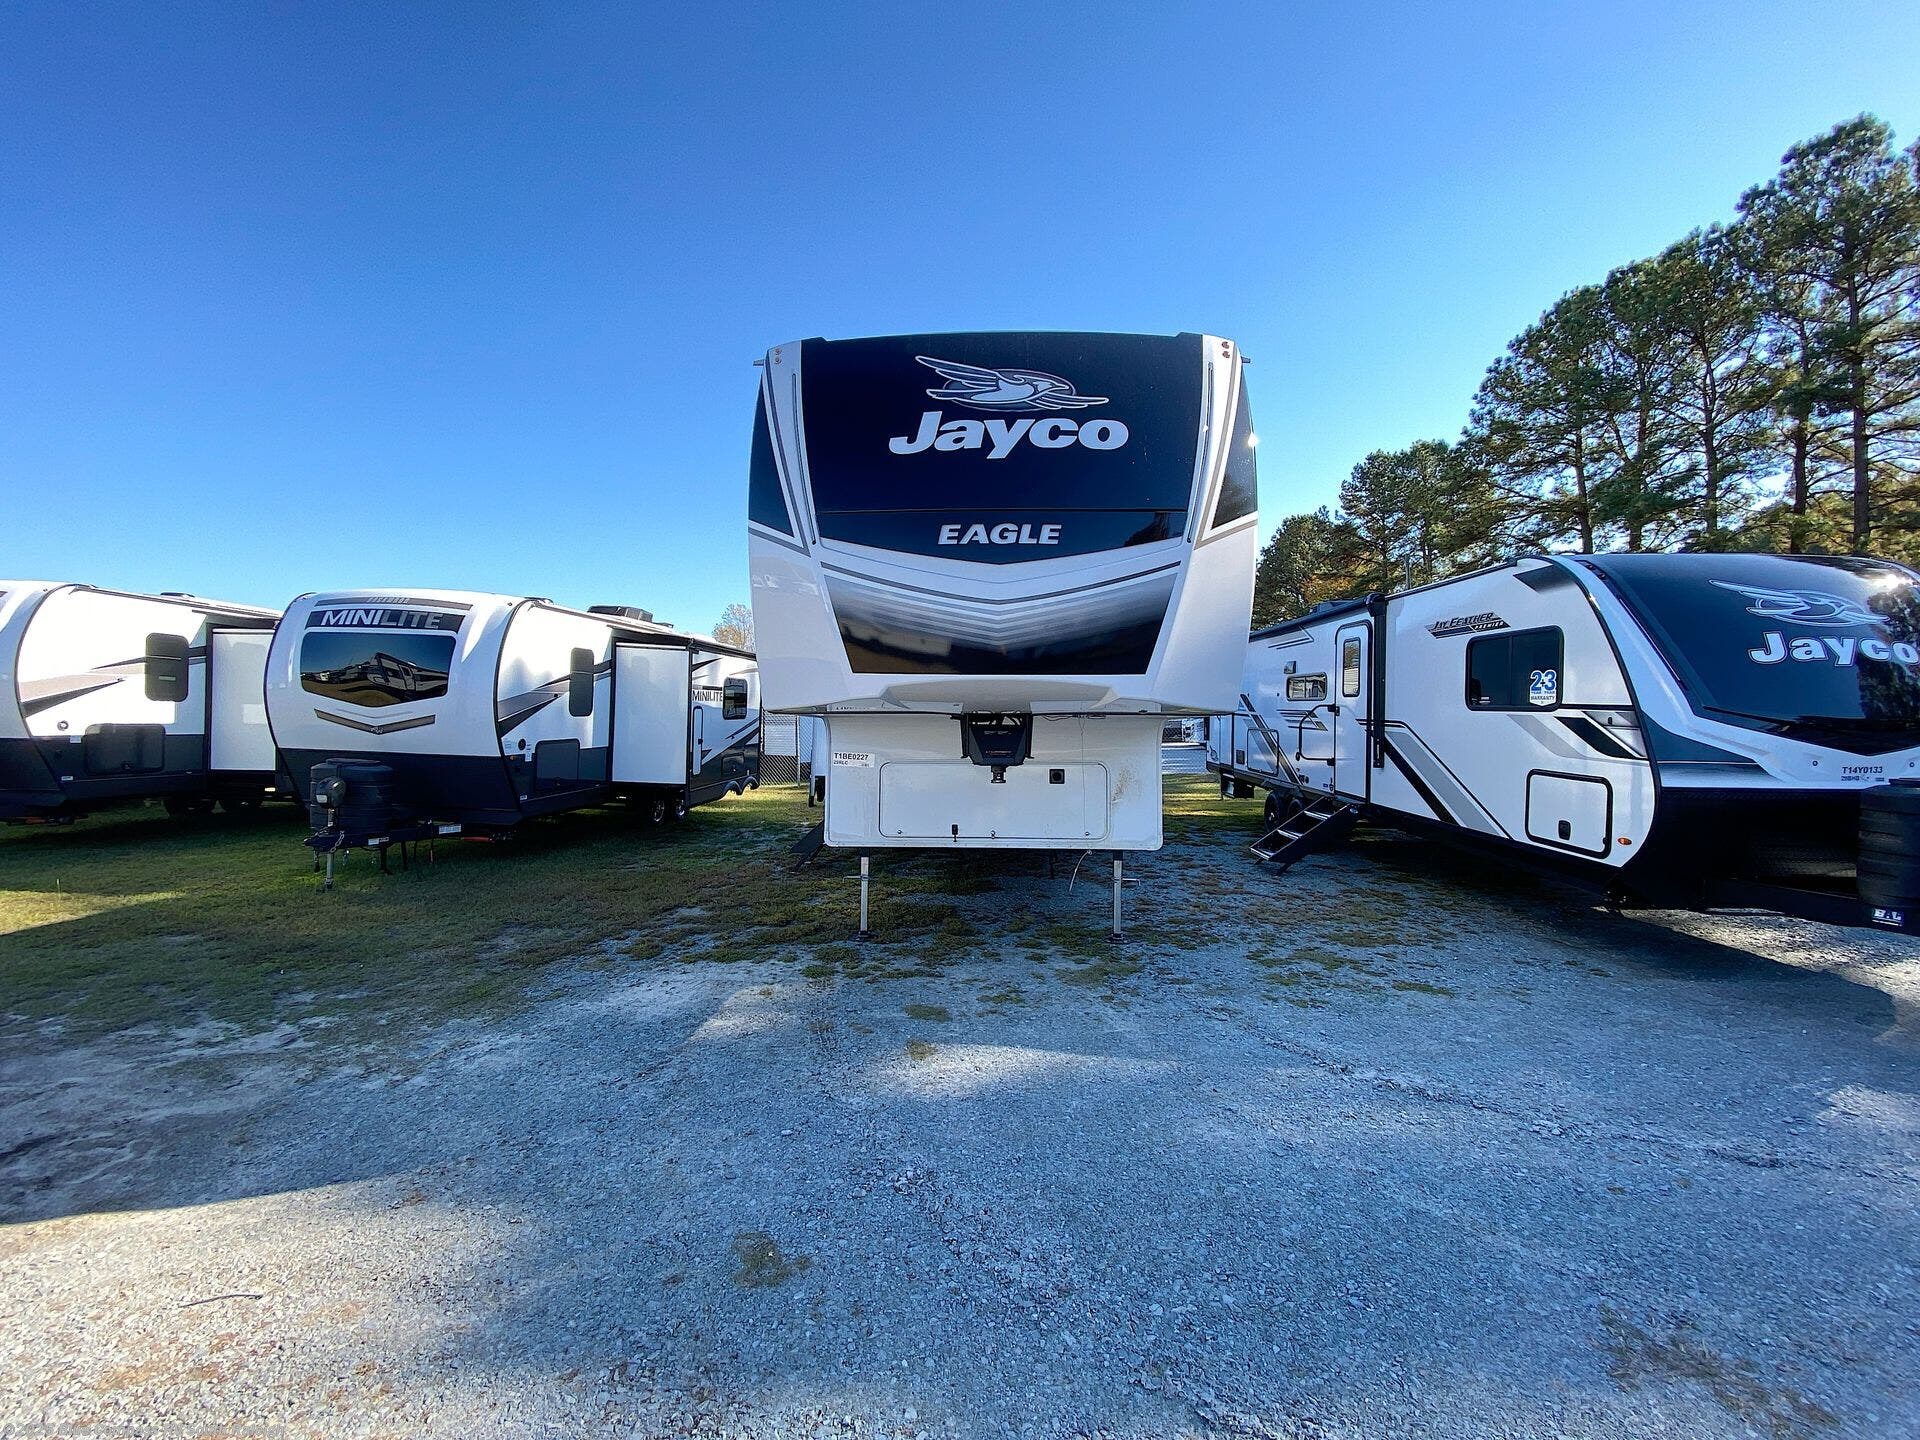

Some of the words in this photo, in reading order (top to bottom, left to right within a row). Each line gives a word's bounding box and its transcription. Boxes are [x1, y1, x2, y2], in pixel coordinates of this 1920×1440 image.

[888, 411, 1129, 459] Jayco
[937, 523, 1062, 546] EAGLE
[321, 609, 442, 629] MINILITE
[1474, 621, 1504, 630] PREMIER
[1749, 631, 1920, 667] Jayco
[692, 690, 723, 702] MINILITE
[833, 752, 869, 760] T1BE0227
[1841, 766, 1883, 774] T14Y0133
